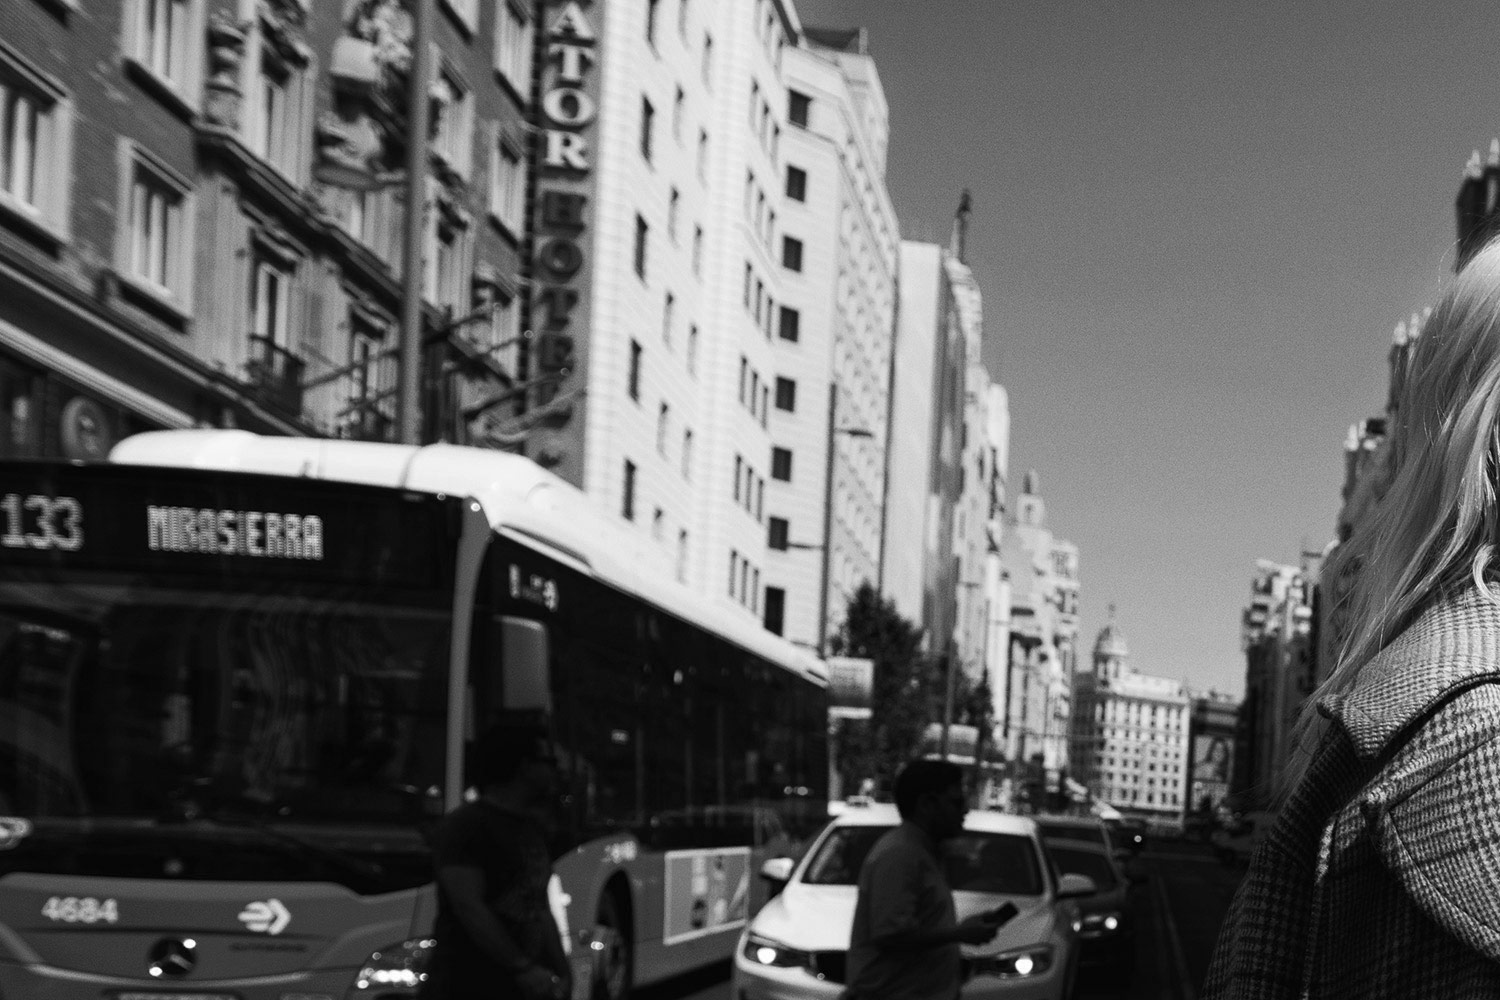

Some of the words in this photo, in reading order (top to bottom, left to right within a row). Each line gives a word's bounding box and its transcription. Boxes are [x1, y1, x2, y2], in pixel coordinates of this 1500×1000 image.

[0, 493, 83, 552] 133
[146, 504, 324, 561] MIRASIERRA
[41, 896, 119, 924] 4684
